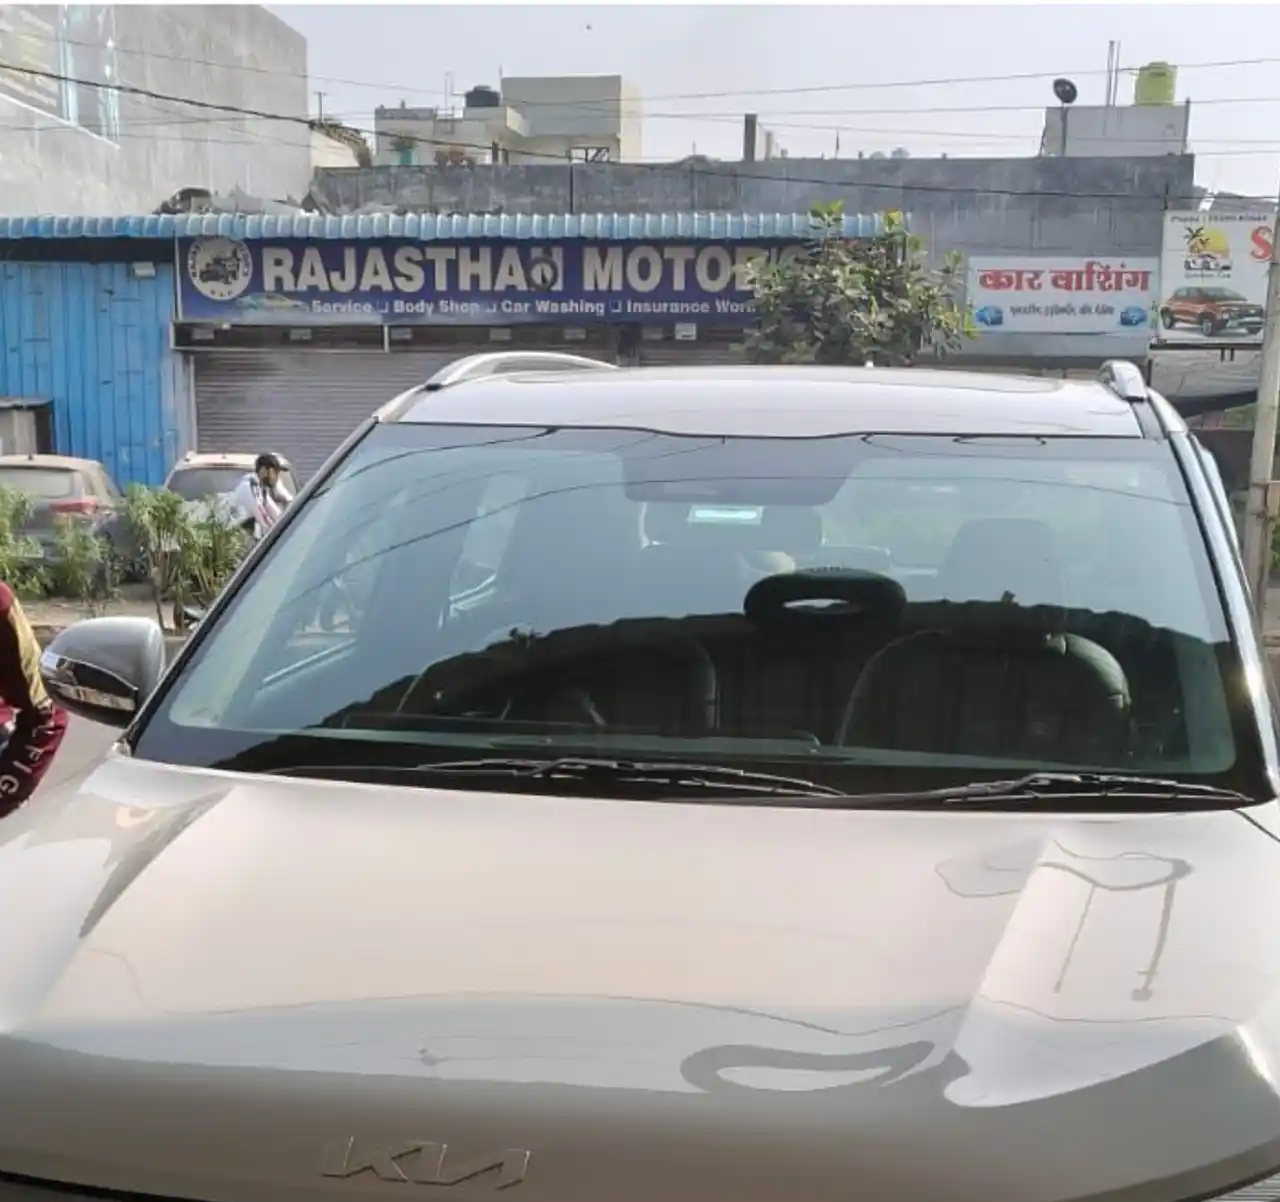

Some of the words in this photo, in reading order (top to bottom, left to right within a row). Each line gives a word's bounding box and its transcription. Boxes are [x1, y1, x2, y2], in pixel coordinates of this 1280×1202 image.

[262, 246, 564, 293] RAJASTHAN
[977, 268, 1045, 290] कार
[312, 299, 372, 314] Service
[393, 299, 434, 316] Body
[439, 299, 480, 316] Shop
[501, 299, 531, 314] Car
[535, 299, 605, 316] Washing
[626, 299, 710, 314] Insurance
